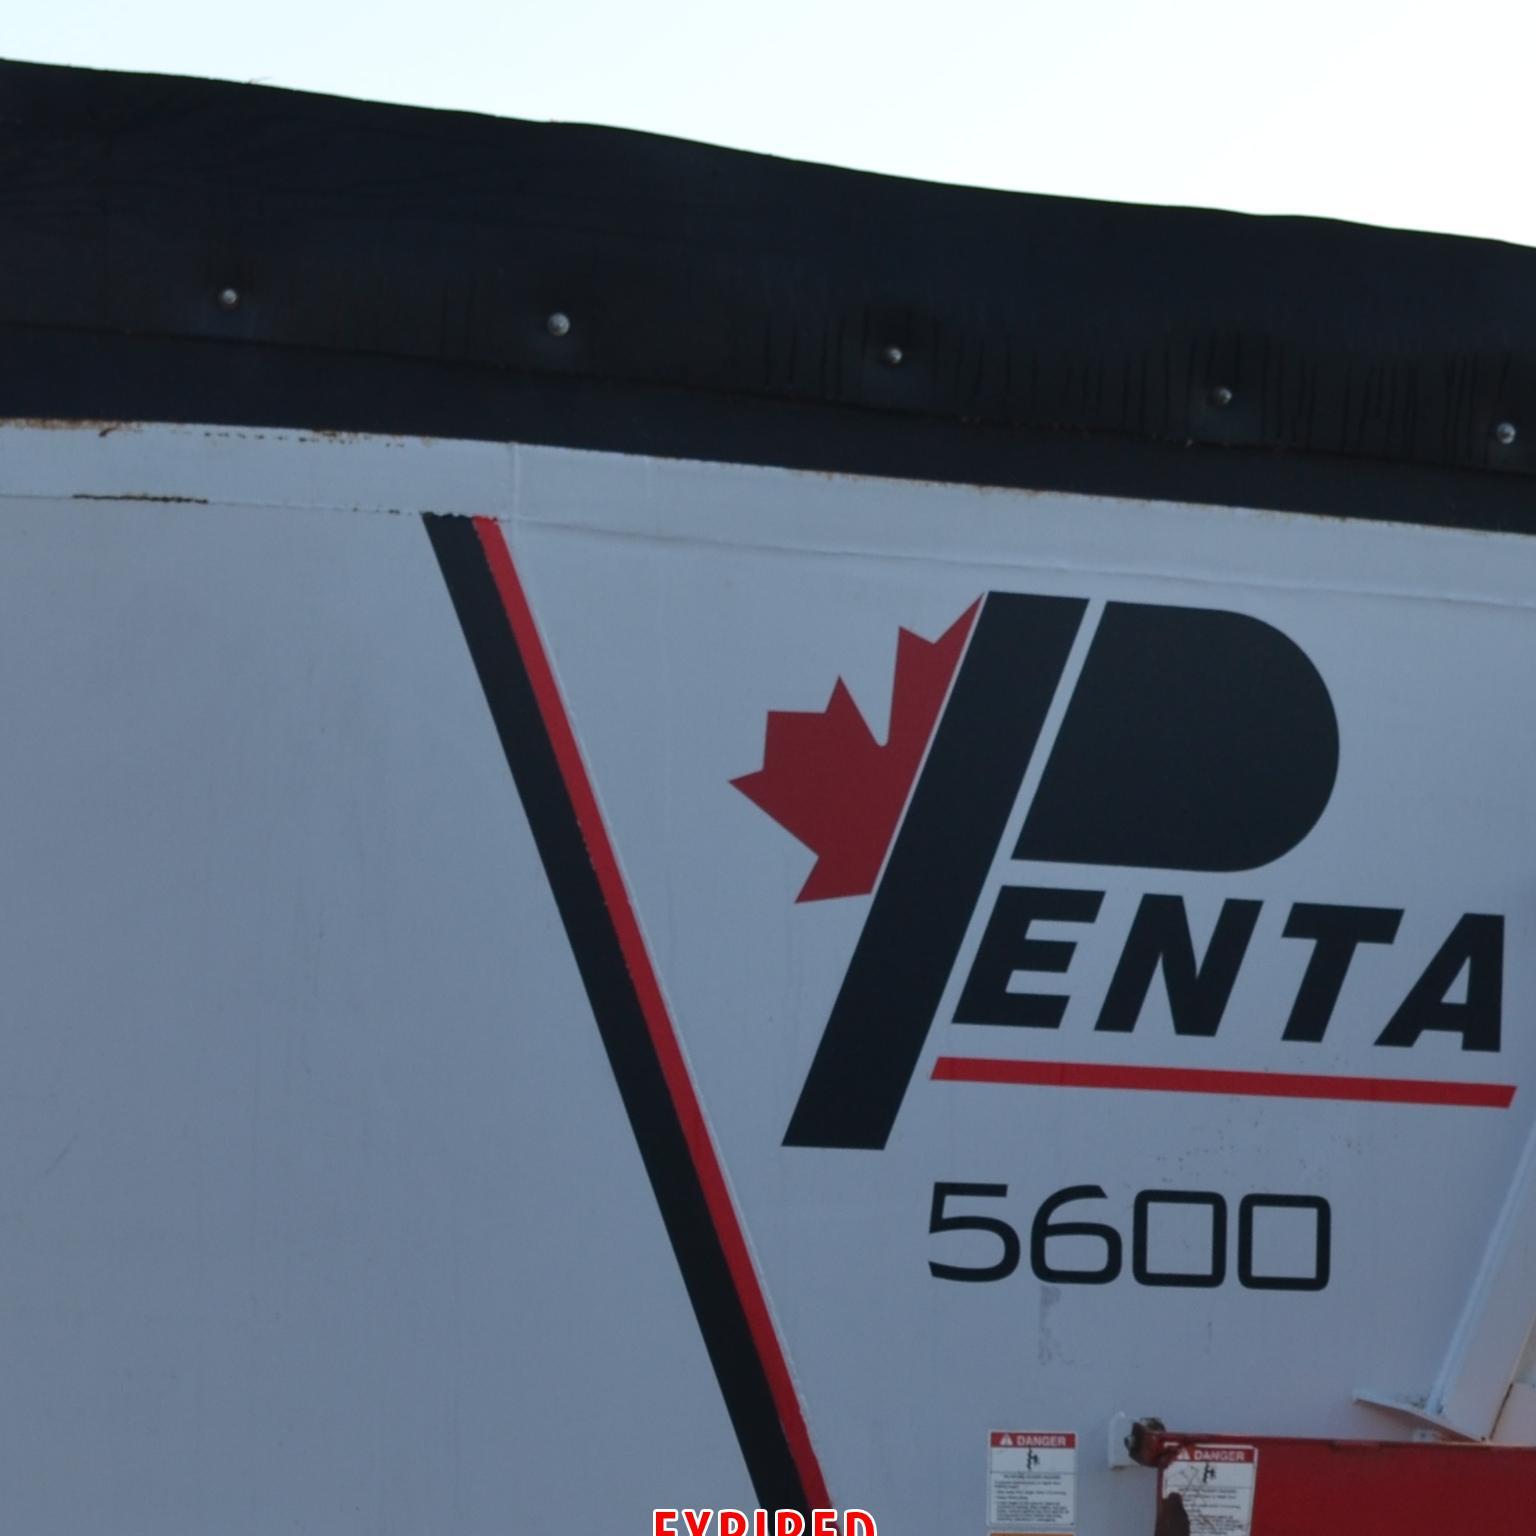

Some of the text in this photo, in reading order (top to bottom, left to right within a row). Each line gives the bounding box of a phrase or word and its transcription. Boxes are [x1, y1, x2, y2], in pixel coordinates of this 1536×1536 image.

[780, 590, 1506, 1151] PENTA
[927, 1181, 1332, 1292] 5600
[1016, 1434, 1067, 1447] DANGER
[1193, 1449, 1246, 1461] DANGER
